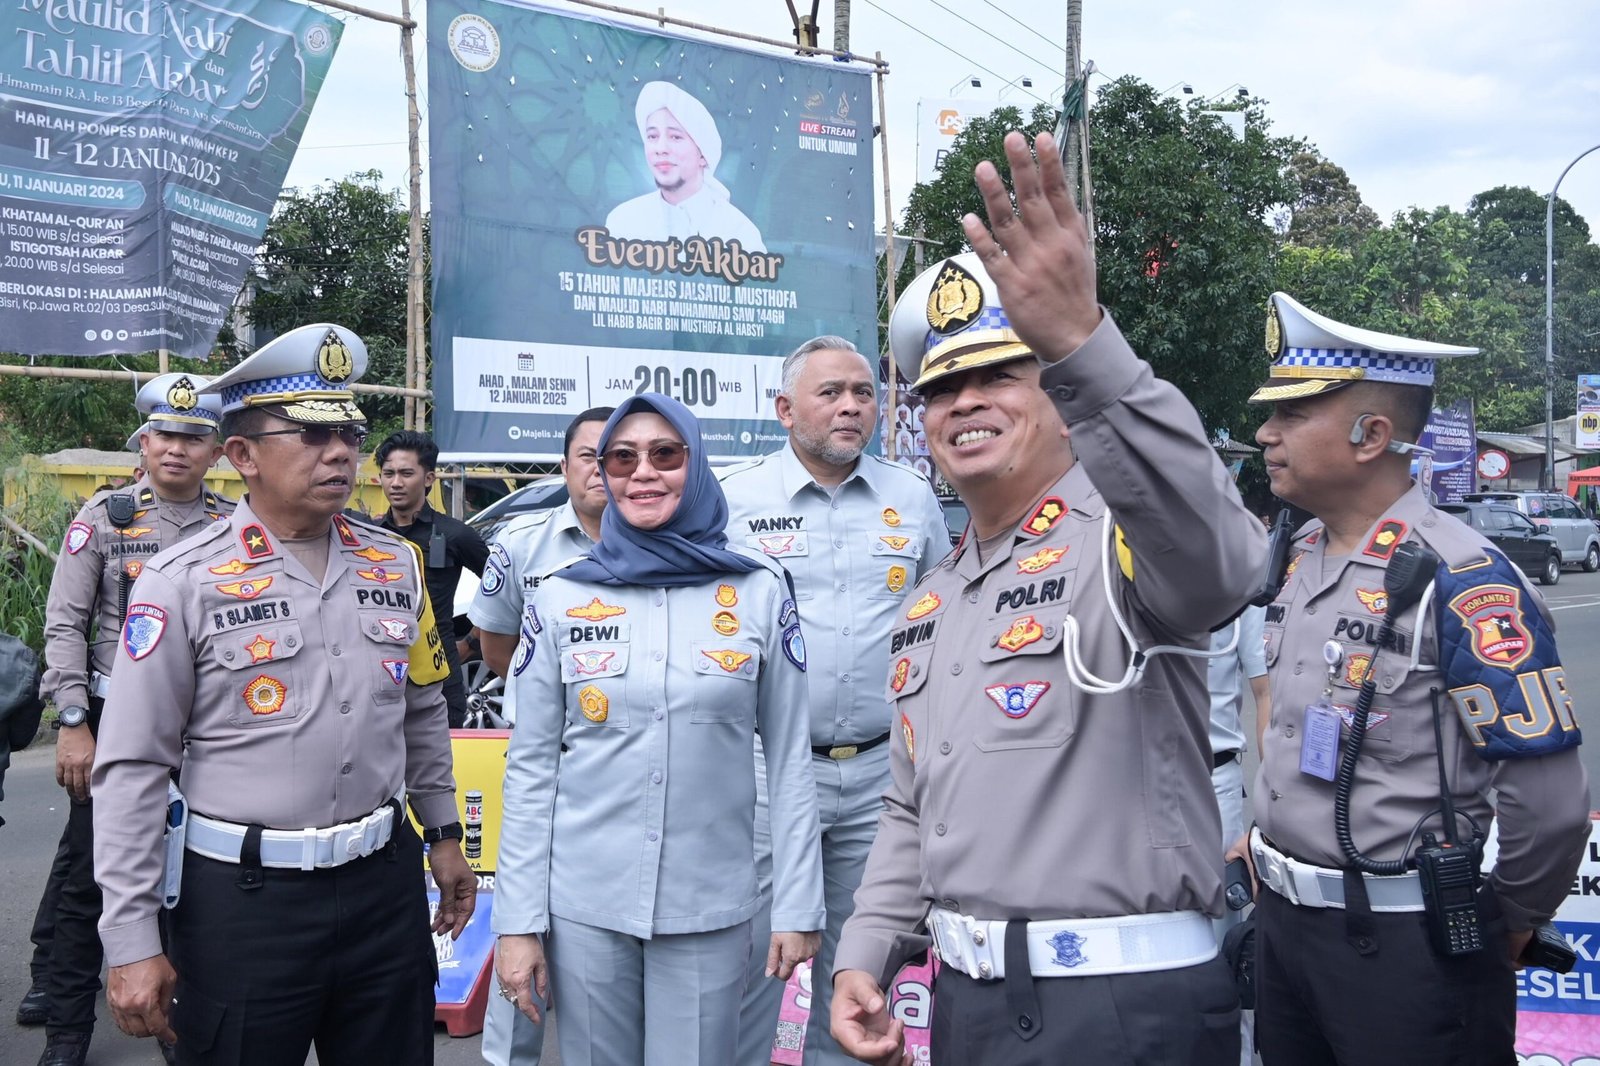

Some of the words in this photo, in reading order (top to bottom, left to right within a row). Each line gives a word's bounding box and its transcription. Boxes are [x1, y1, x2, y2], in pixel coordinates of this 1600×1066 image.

[160, 1, 234, 60] Nabi
[16, 27, 124, 87] Tahlil
[131, 50, 240, 110] Akbar
[205, 59, 225, 77] dan
[94, 91, 109, 103] ke
[112, 95, 123, 106] 13
[15, 109, 75, 133] HARLAH
[78, 121, 137, 139] PONPES
[140, 126, 179, 144] DARUL
[800, 122, 820, 133] LIVE
[821, 125, 856, 138] STREAM
[799, 135, 827, 152] UNTUK
[828, 140, 857, 156] UMUM
[35, 136, 49, 160] 11
[75, 141, 98, 166] 12
[187, 157, 221, 186] 2025
[13, 174, 23, 189] 11
[25, 177, 87, 197] JANUARI
[89, 185, 124, 200] 2024
[2, 207, 53, 225] KHATAM
[55, 214, 124, 230] AL-QUR'AN
[200, 202, 235, 222] JANUARI
[235, 212, 258, 229] 2024
[7, 223, 34, 238] 15.00
[36, 227, 58, 241] WIB
[60, 227, 80, 244] s/d
[82, 232, 124, 245] Selesai
[10, 240, 80, 258] ISTIGOTSAH
[82, 247, 126, 260] AKBAR
[577, 228, 681, 272] Event
[686, 238, 783, 284] Akbar
[5, 255, 34, 270] 20.00
[36, 259, 58, 272] WIB
[60, 259, 80, 275] s/d
[82, 262, 125, 275] Selesai
[0, 281, 65, 298] BERLOKASI
[68, 286, 81, 299] DI
[90, 287, 151, 300] HALAMAN
[206, 275, 218, 290] s/d
[218, 280, 241, 294] Selesa
[559, 271, 574, 292] 15
[576, 273, 621, 295] TAHUN
[623, 276, 677, 299] MAJELIS
[679, 281, 733, 304] JALSATUL
[735, 286, 797, 309] MUSTHOFA
[73, 301, 121, 315] Rt.02/03
[574, 294, 596, 311] DAN
[599, 296, 640, 314] MAULID
[642, 299, 667, 315] NABI
[669, 301, 730, 320] MUHAMMAD
[733, 307, 755, 323] SAW
[756, 309, 785, 324] 1446H
[593, 313, 606, 328] LIL
[607, 314, 635, 329] HABIB
[637, 316, 663, 331] BAGIR
[665, 317, 680, 332] BIN
[681, 318, 723, 335] MUSTHOFA
[724, 322, 735, 335] AL
[736, 322, 764, 338] HABSYI
[479, 374, 504, 389] AHAD
[511, 376, 548, 391] MALAM
[549, 378, 576, 392] SENIN
[605, 378, 634, 391] JAM
[634, 365, 717, 407] 20:00
[718, 381, 742, 393] WIB
[489, 389, 500, 403] 12
[502, 390, 541, 405] JANUARI
[543, 392, 567, 406] 2025
[1582, 416, 1598, 430] nbp
[522, 429, 551, 440] Majelis
[701, 433, 735, 441] Musthofa
[748, 516, 803, 533] VANKY
[110, 542, 160, 557] NANANG
[523, 576, 542, 589] HE
[356, 589, 412, 610] POLRI
[995, 576, 1066, 613] POLRI
[1462, 593, 1511, 612] KORLANTAS
[213, 613, 225, 630] R
[228, 602, 278, 626] SLAMET
[280, 600, 290, 617] S
[570, 625, 619, 643] DEWI
[890, 620, 936, 655] EDWIN
[1334, 617, 1405, 653] POLRI
[1448, 666, 1579, 747] PJR
[466, 806, 482, 816] ABC
